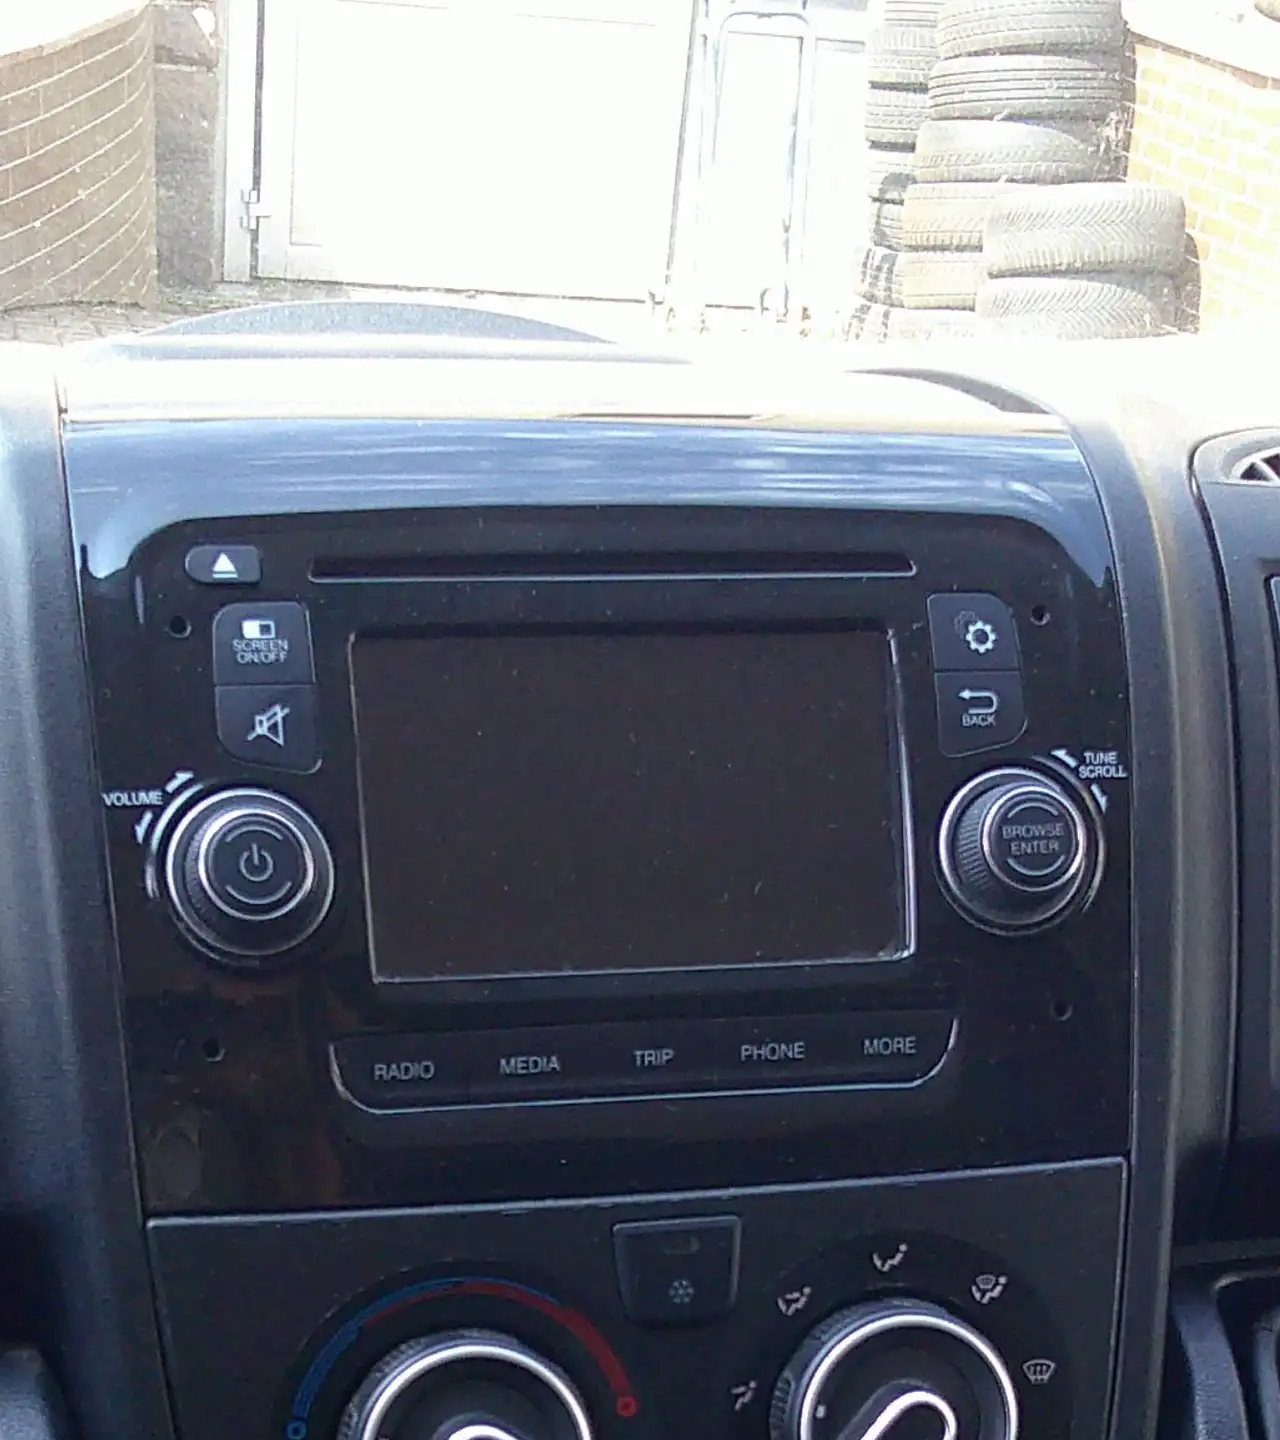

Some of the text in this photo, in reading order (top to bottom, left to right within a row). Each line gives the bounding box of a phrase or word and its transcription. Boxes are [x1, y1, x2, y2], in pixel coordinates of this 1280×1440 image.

[232, 639, 288, 652] SCREEN
[237, 651, 287, 664] ON/OFF
[962, 715, 996, 727] BACK
[1084, 753, 1117, 765] TUNE
[1079, 765, 1127, 779] SCROLL
[103, 792, 163, 806] VOLUME
[1002, 822, 1065, 840] BROWSE
[1011, 840, 1059, 856] ENTER
[374, 1036, 916, 1081] RADIO MEDIA TRIP PHONE MORE
